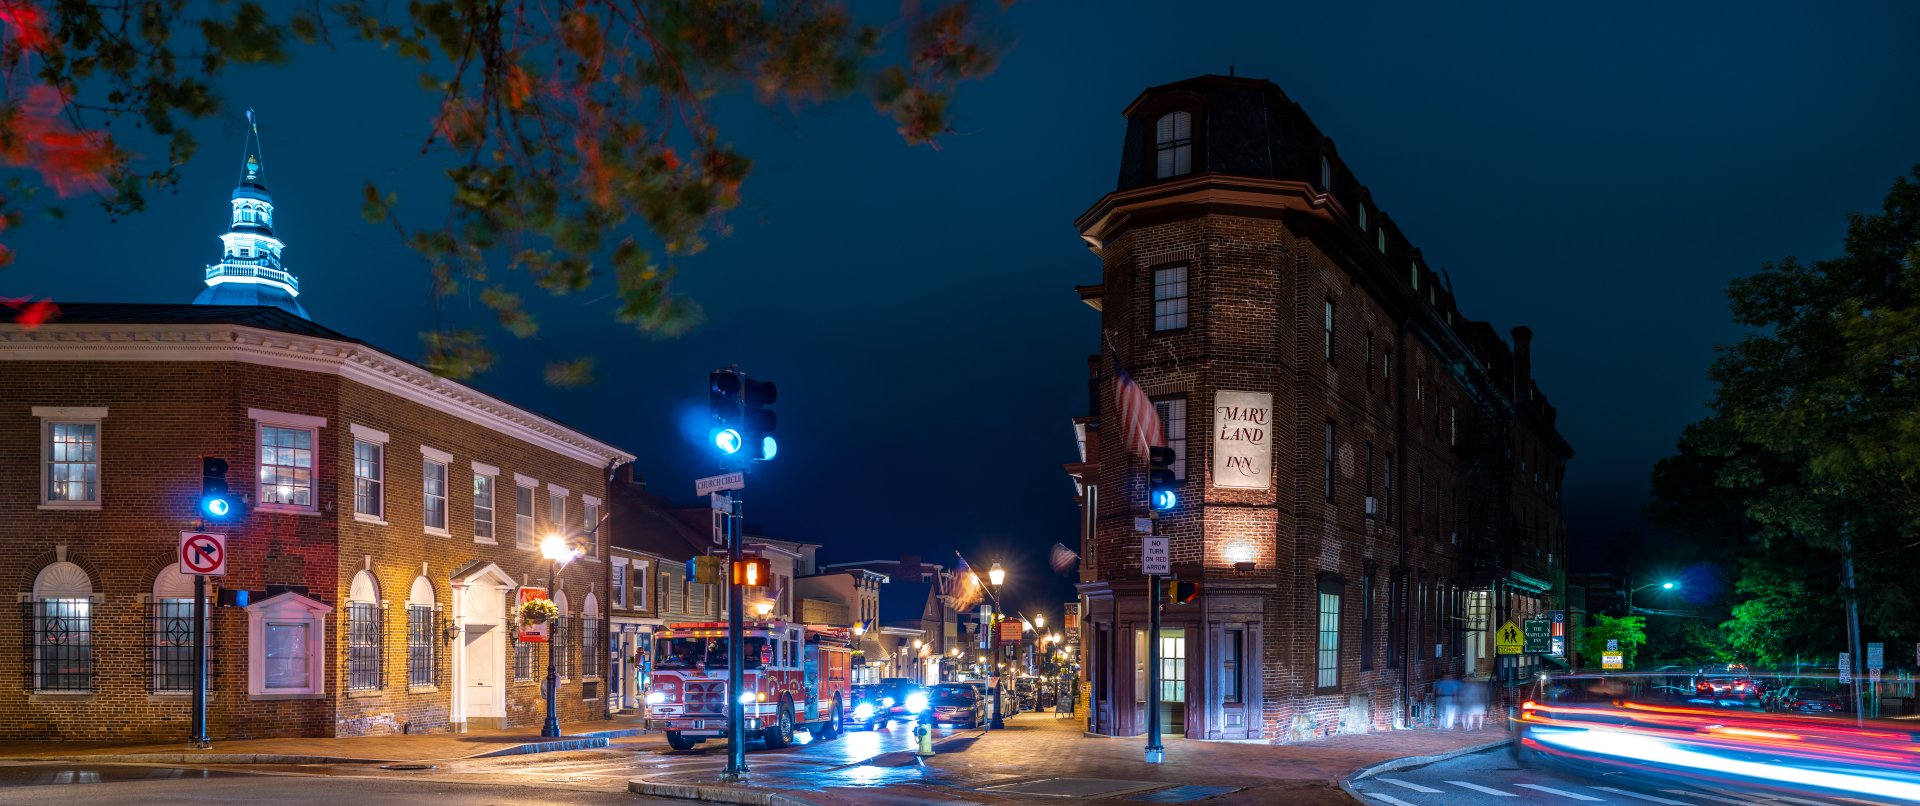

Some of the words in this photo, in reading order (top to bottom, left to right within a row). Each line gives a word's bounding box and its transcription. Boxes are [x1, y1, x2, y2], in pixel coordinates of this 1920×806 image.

[1217, 406, 1270, 426] MARY
[1219, 426, 1264, 446] LAND
[1226, 456, 1260, 477] INN
[697, 478, 720, 490] CHURCH
[721, 474, 742, 486] CIRCLE
[687, 682, 723, 713] 36
